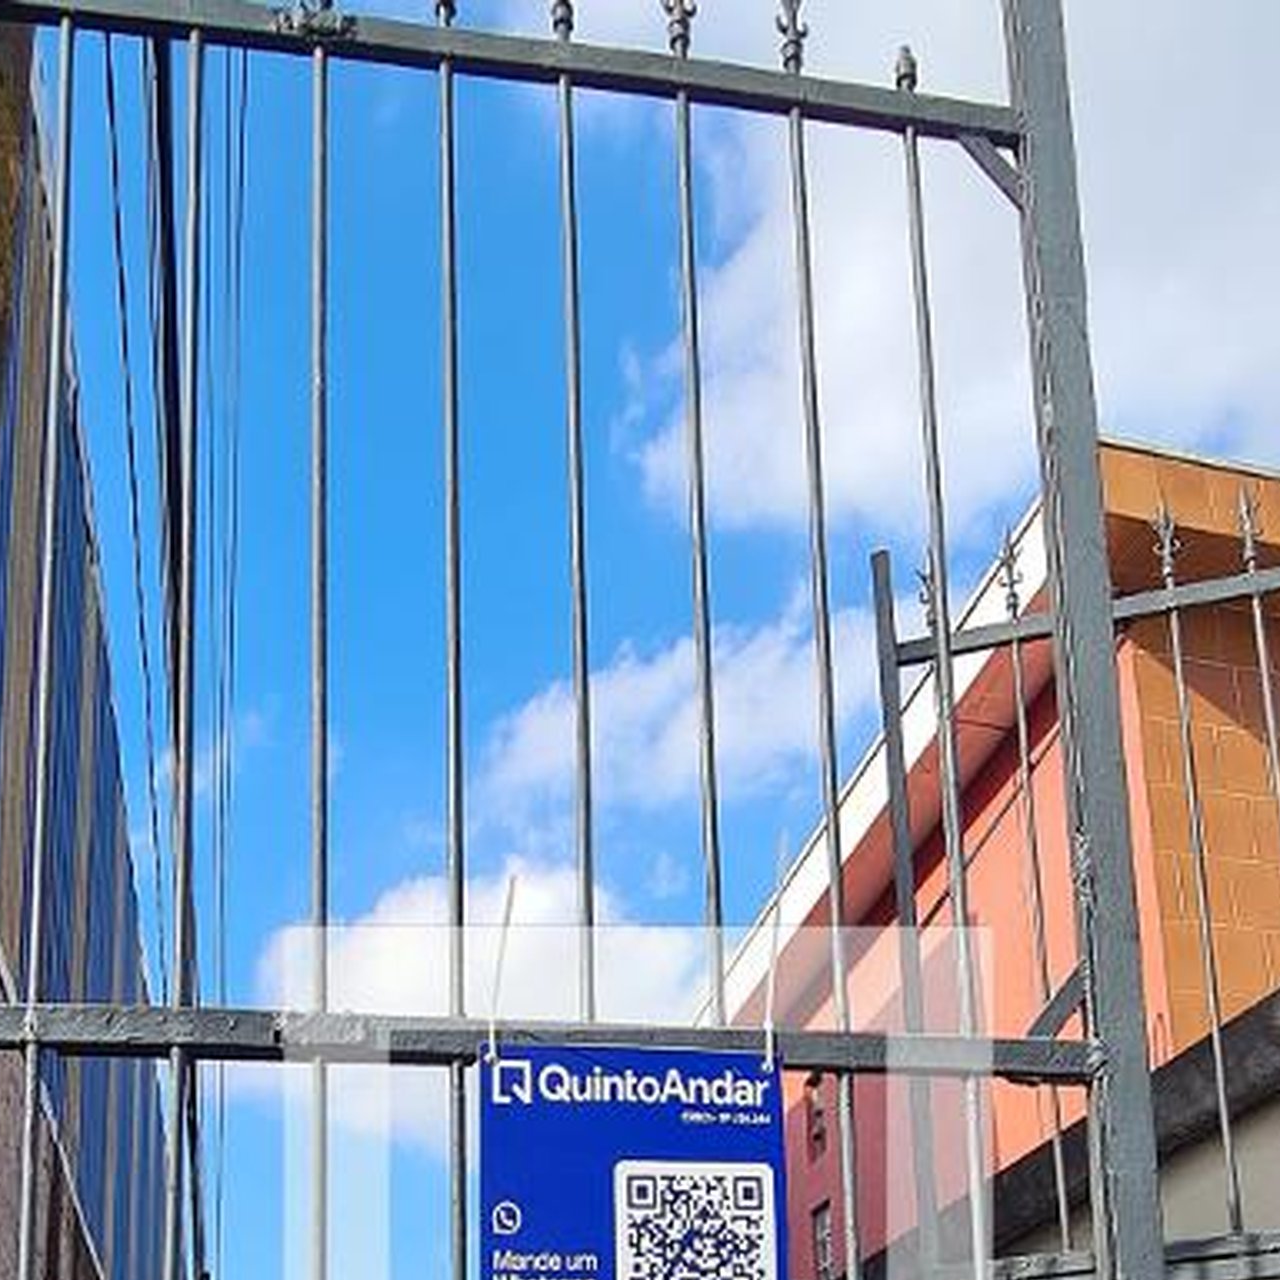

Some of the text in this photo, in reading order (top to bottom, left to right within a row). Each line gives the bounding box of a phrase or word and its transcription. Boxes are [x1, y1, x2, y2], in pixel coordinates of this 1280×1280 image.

[538, 1064, 770, 1106] QuintoAndar
[493, 1250, 598, 1271] Mande um
